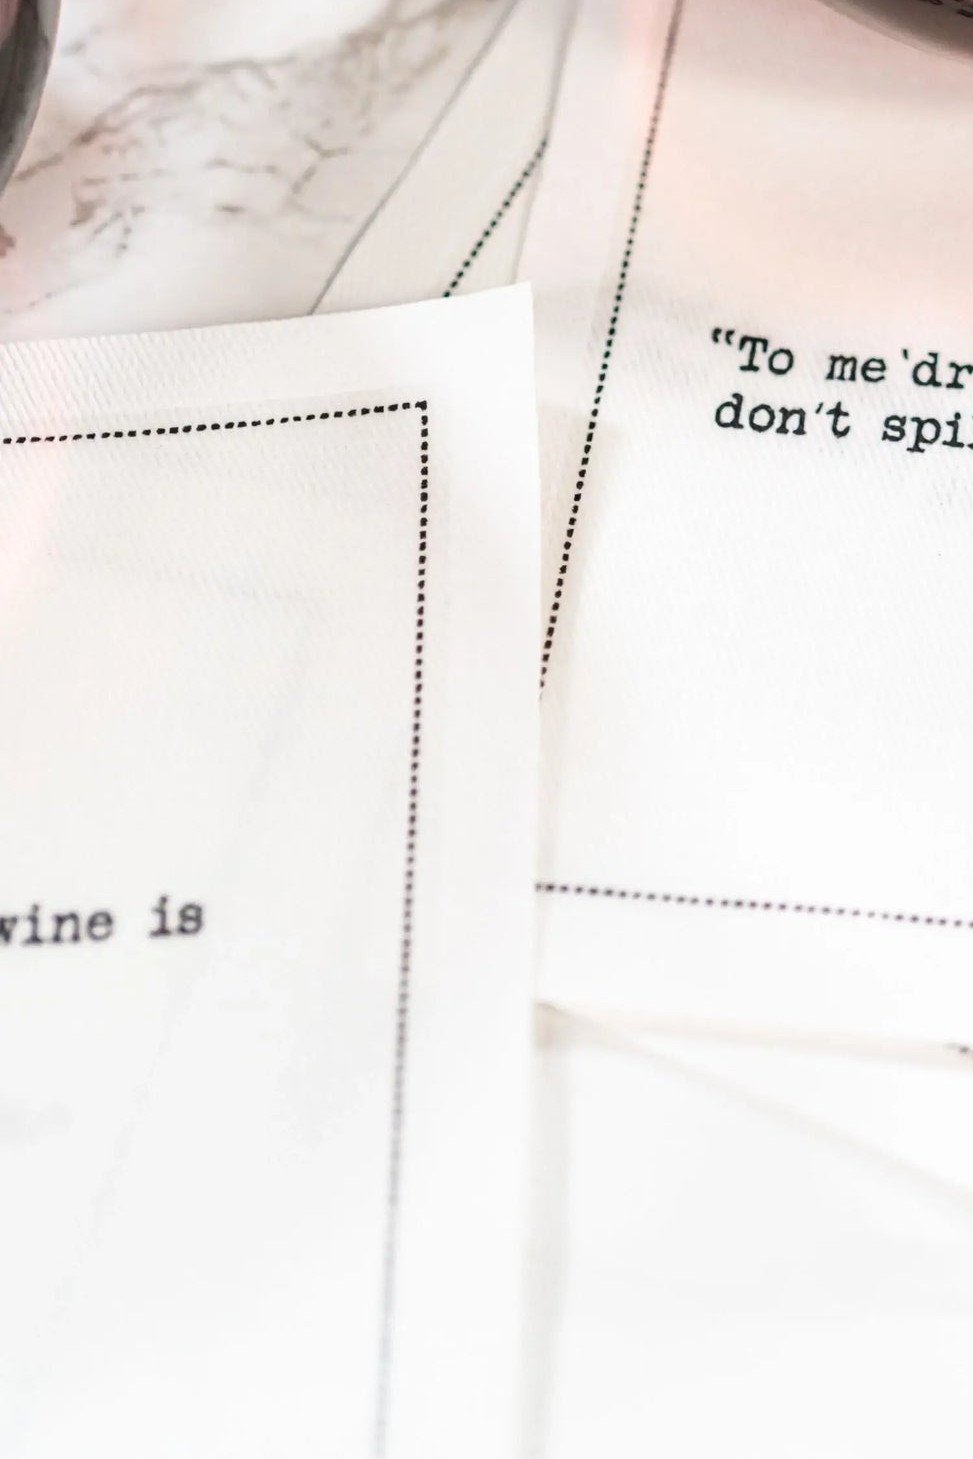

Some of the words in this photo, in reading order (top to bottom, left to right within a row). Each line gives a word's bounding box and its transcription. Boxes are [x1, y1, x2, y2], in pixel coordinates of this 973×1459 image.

[711, 327, 795, 376] “To
[825, 354, 887, 384] me
[714, 392, 851, 439] don't
[149, 895, 204, 938] is
